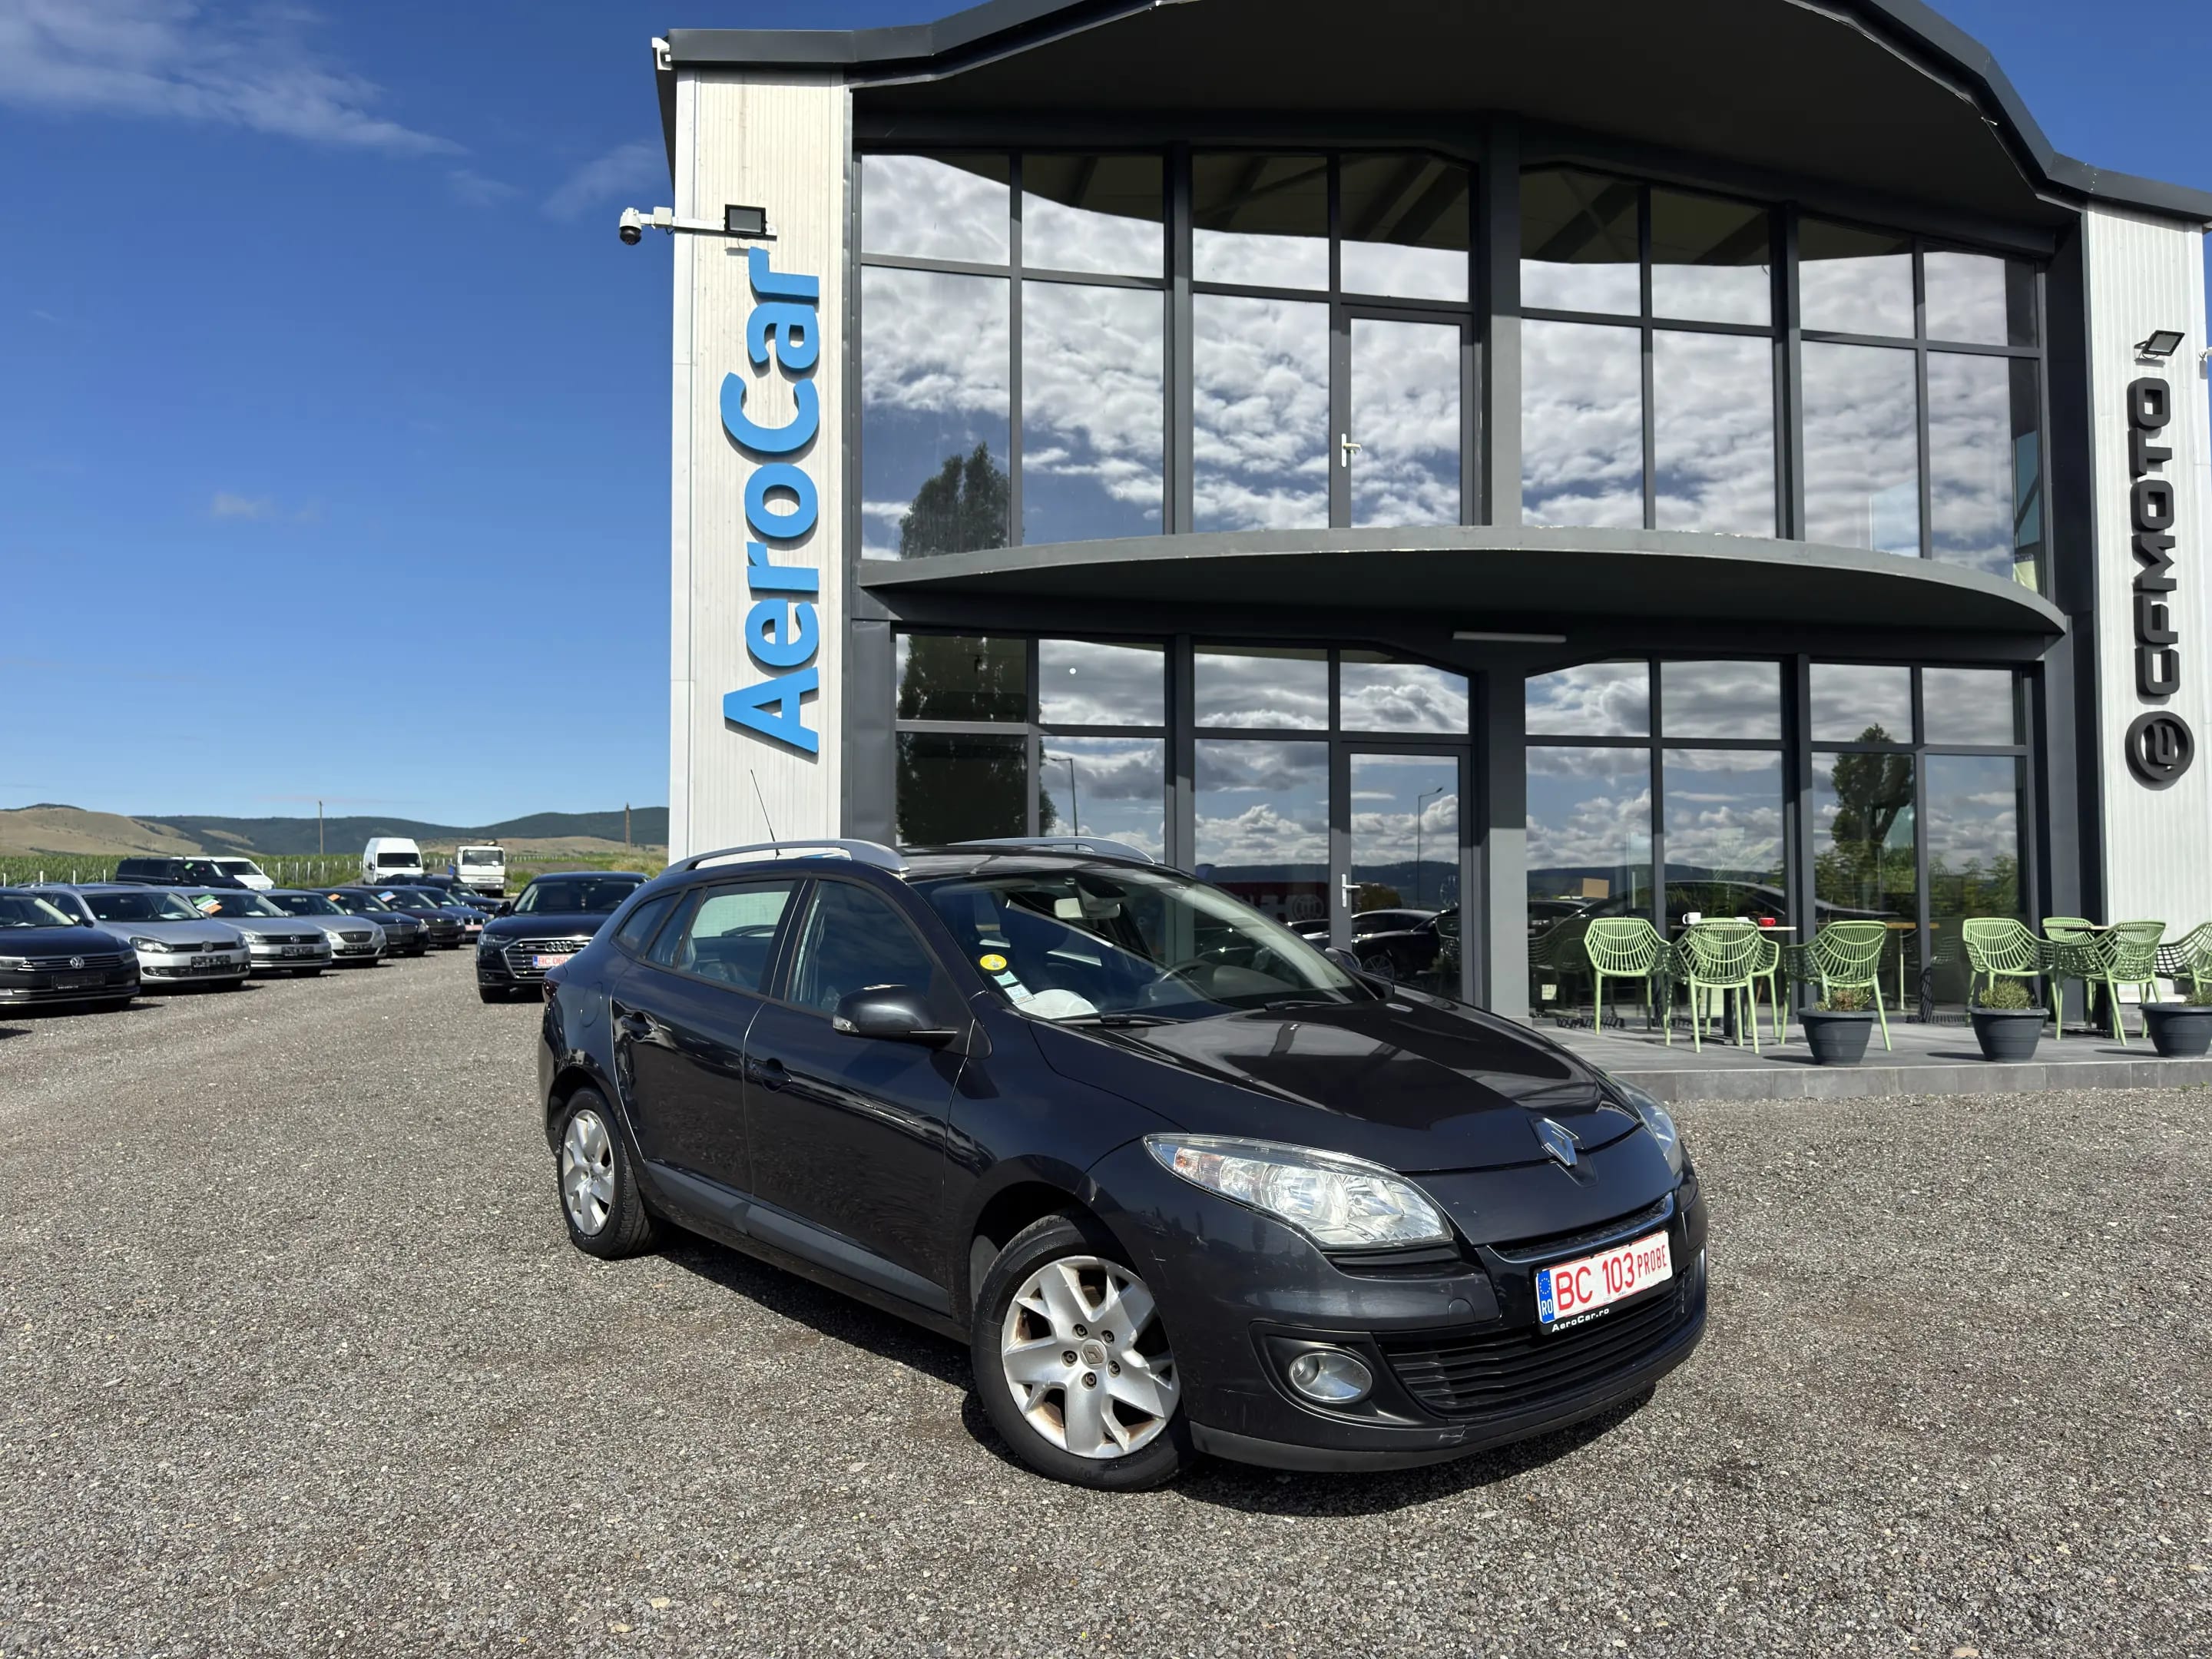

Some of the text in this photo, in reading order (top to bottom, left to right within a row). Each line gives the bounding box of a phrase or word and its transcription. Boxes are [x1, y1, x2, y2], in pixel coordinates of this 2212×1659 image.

[720, 246, 820, 754] AeroCar
[2127, 377, 2181, 695] CFMOTO
[538, 957, 551, 965] BC
[1555, 1244, 1667, 1311] BC 103 PROBE
[1541, 1298, 1554, 1316] RO
[1551, 1308, 1610, 1333] AeroCar.ro
